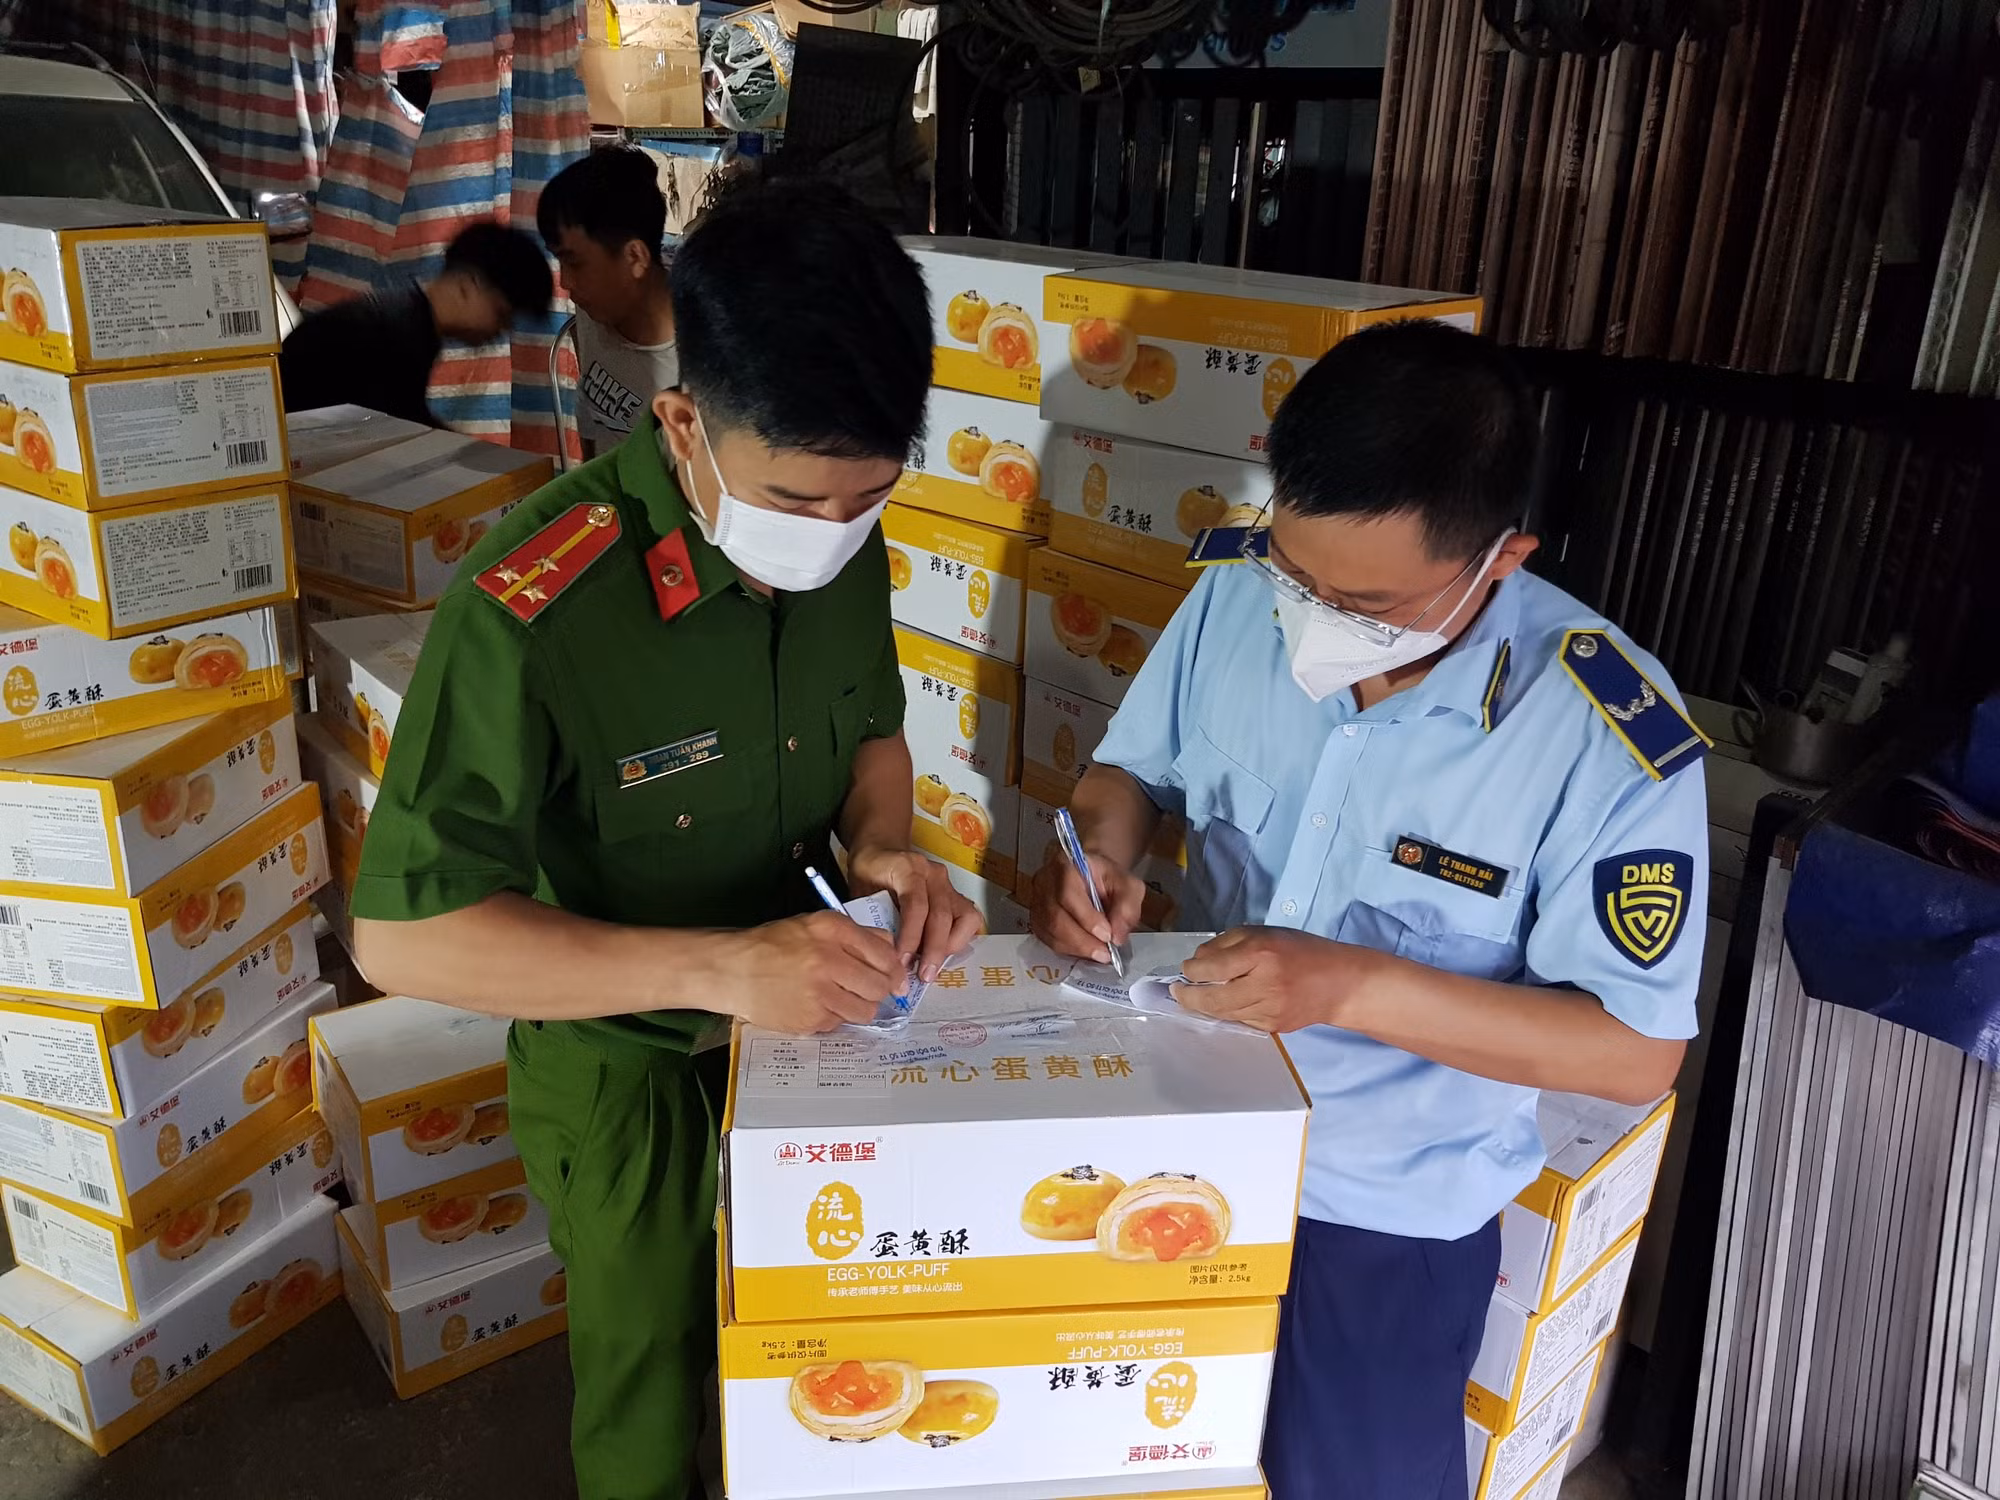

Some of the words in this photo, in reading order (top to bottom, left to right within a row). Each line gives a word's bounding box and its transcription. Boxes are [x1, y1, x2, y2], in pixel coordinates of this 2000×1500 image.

[45, 683, 105, 711] 蛋黄酥
[690, 750, 709, 762] 289
[1622, 863, 1675, 884] DMS
[936, 965, 1060, 989] 心蛋黄
[891, 1055, 1134, 1084] 流心蛋黄酥
[805, 1142, 877, 1163] 艾德堡
[817, 1191, 861, 1247] 流心
[870, 1228, 970, 1258] 蛋黄酥
[827, 1263, 951, 1282] EGG-YOLK-PUFF
[1189, 1263, 1248, 1274] 图片仅供参考
[1228, 1275, 1251, 1283] 2.5kg
[827, 1285, 899, 1298] 传承老师傅手艺
[902, 1282, 963, 1295] 美味从心流出
[760, 1338, 786, 1349] 2.5kg
[766, 1348, 827, 1360] 图片仅供参考
[1066, 1341, 1184, 1359] EGG-YOLK-PUFF
[1047, 1363, 1142, 1391] 蛋黄酥
[1150, 1371, 1188, 1418] 流心
[1127, 1442, 1191, 1463] 艾德堡
